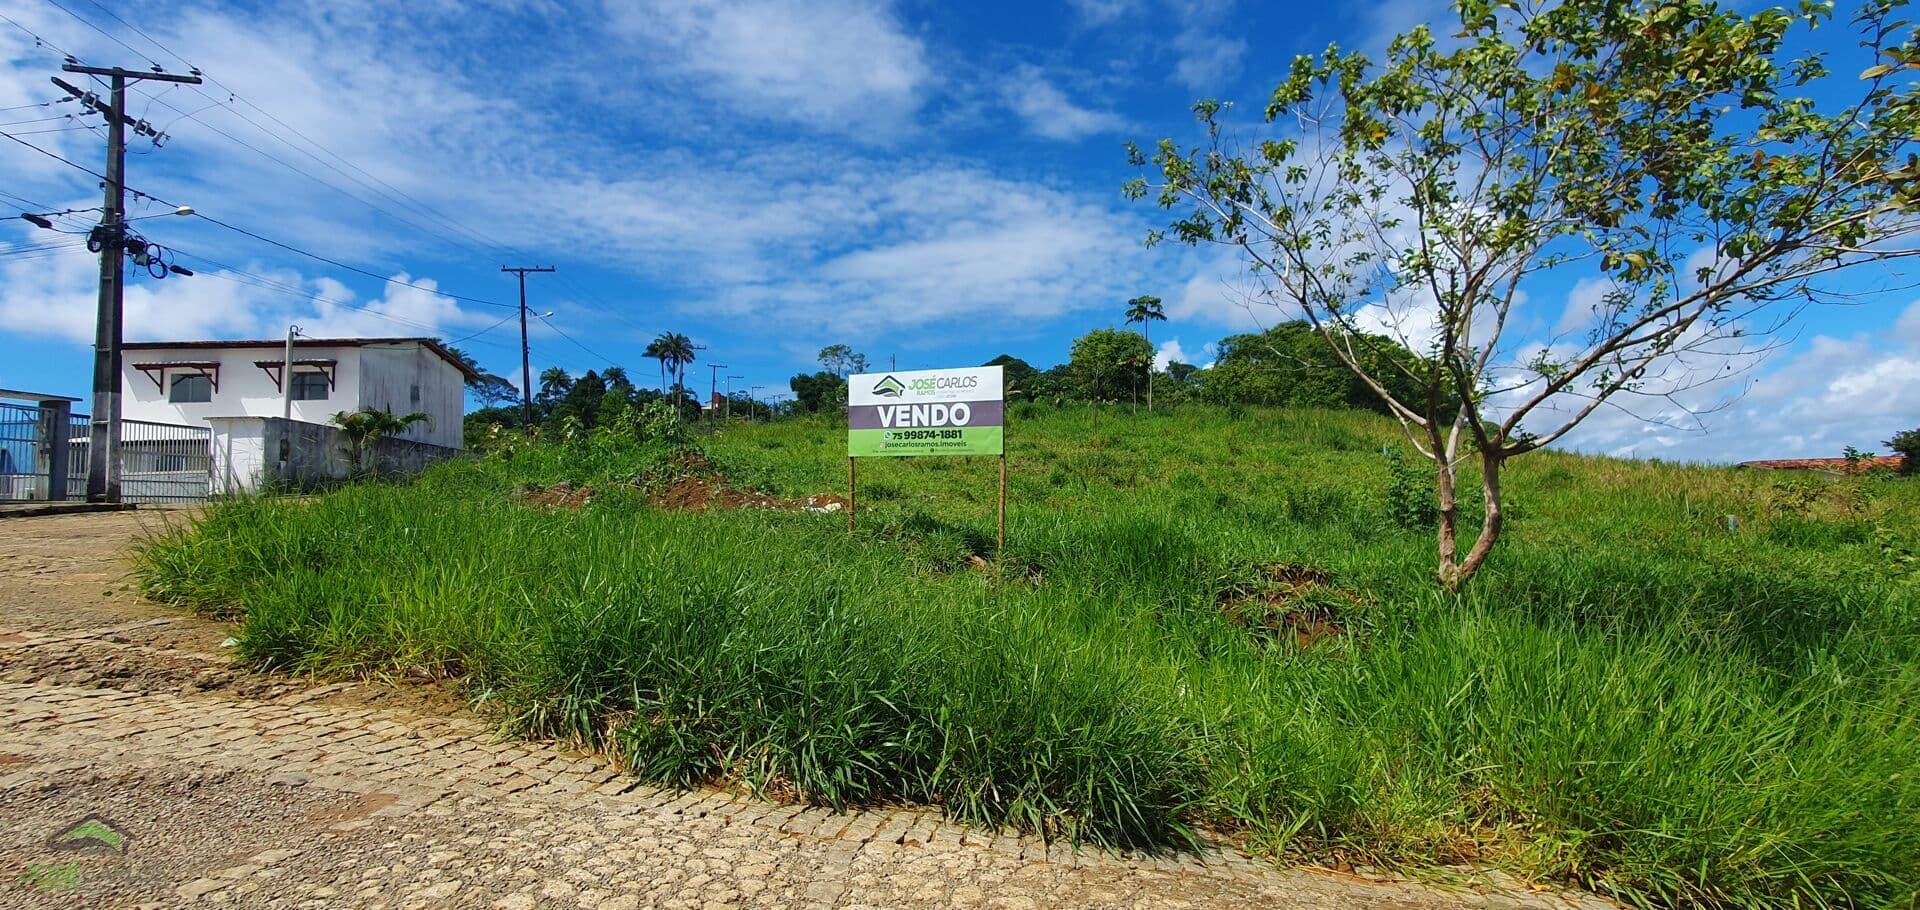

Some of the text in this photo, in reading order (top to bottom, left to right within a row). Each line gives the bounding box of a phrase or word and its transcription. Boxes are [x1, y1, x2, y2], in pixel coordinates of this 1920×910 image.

[936, 376, 978, 389] CARLOS
[877, 403, 971, 428] VENDO
[892, 430, 962, 440] 75 99874-1881
